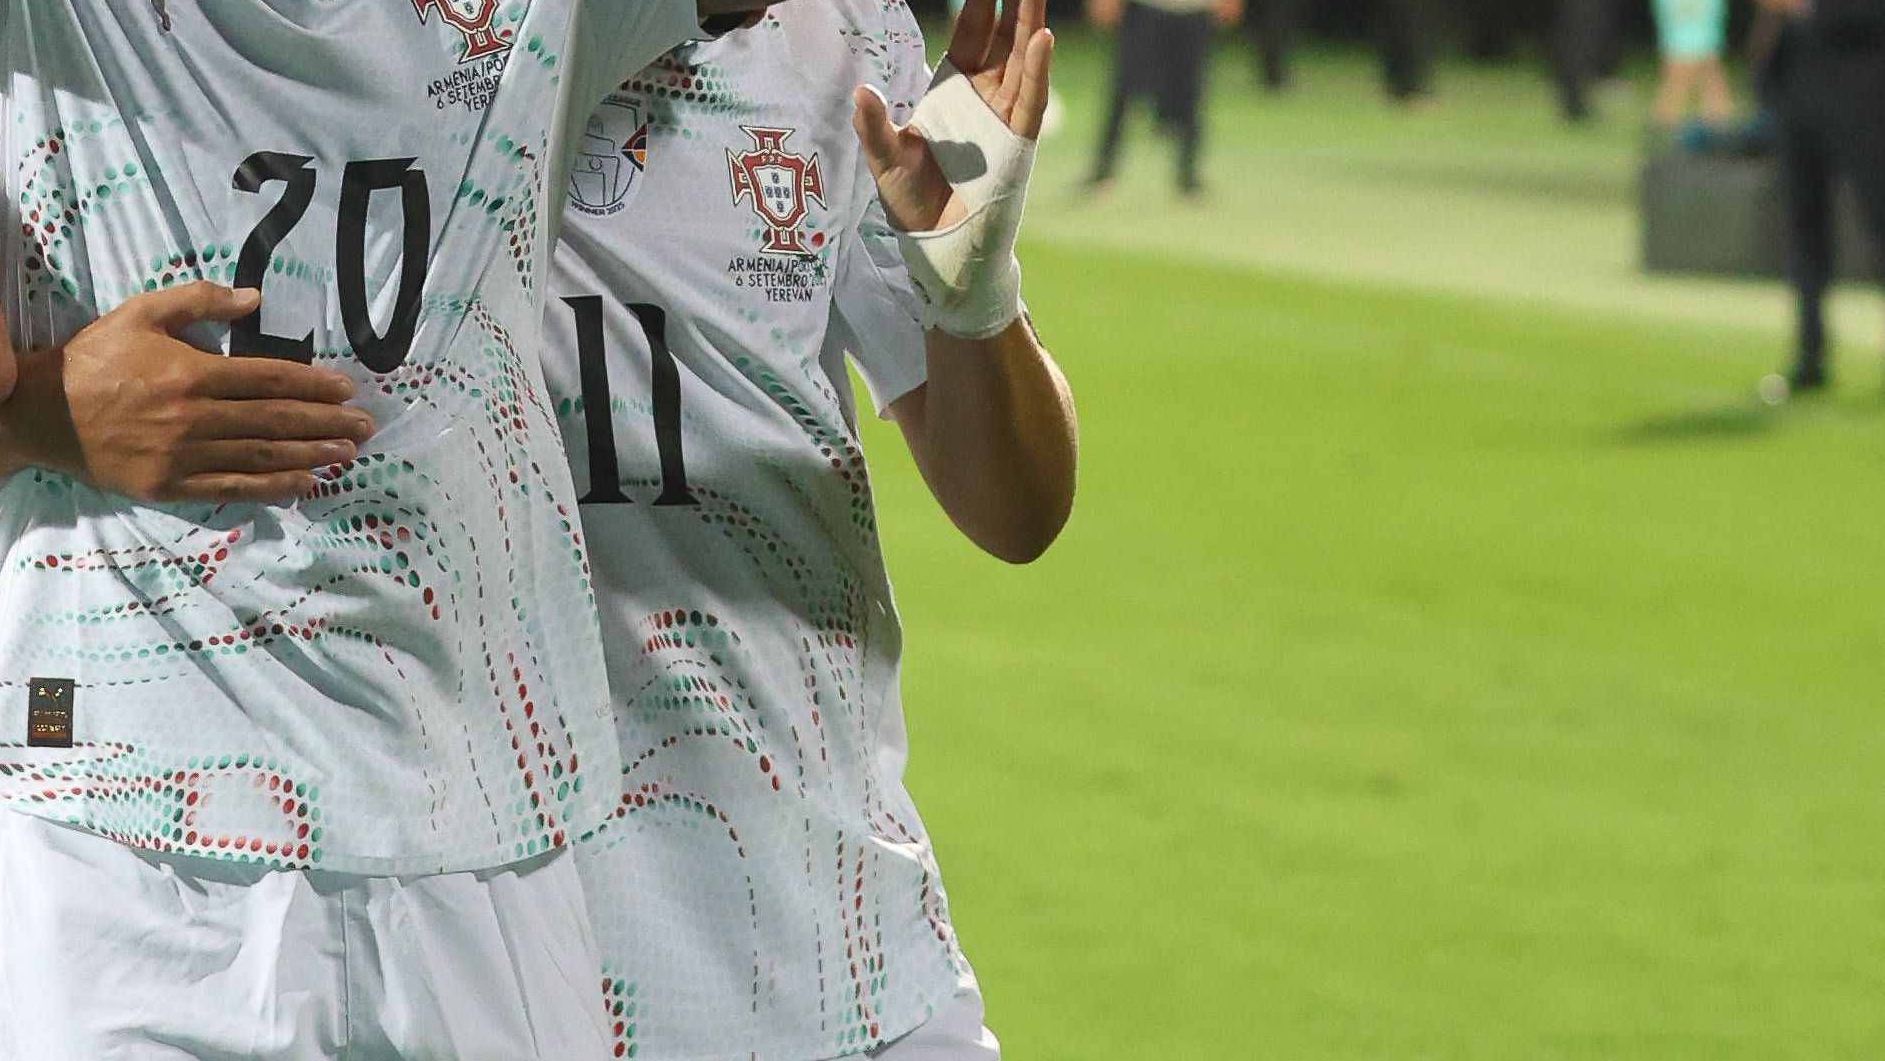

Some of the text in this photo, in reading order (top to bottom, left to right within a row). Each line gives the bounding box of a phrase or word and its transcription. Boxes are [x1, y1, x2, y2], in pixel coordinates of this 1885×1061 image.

[436, 94, 445, 110] 6
[231, 151, 432, 375] 20
[735, 274, 744, 287] 6
[749, 273, 809, 288] SETEMBRO
[764, 287, 813, 303] YEREVAN
[559, 294, 702, 507] 11
